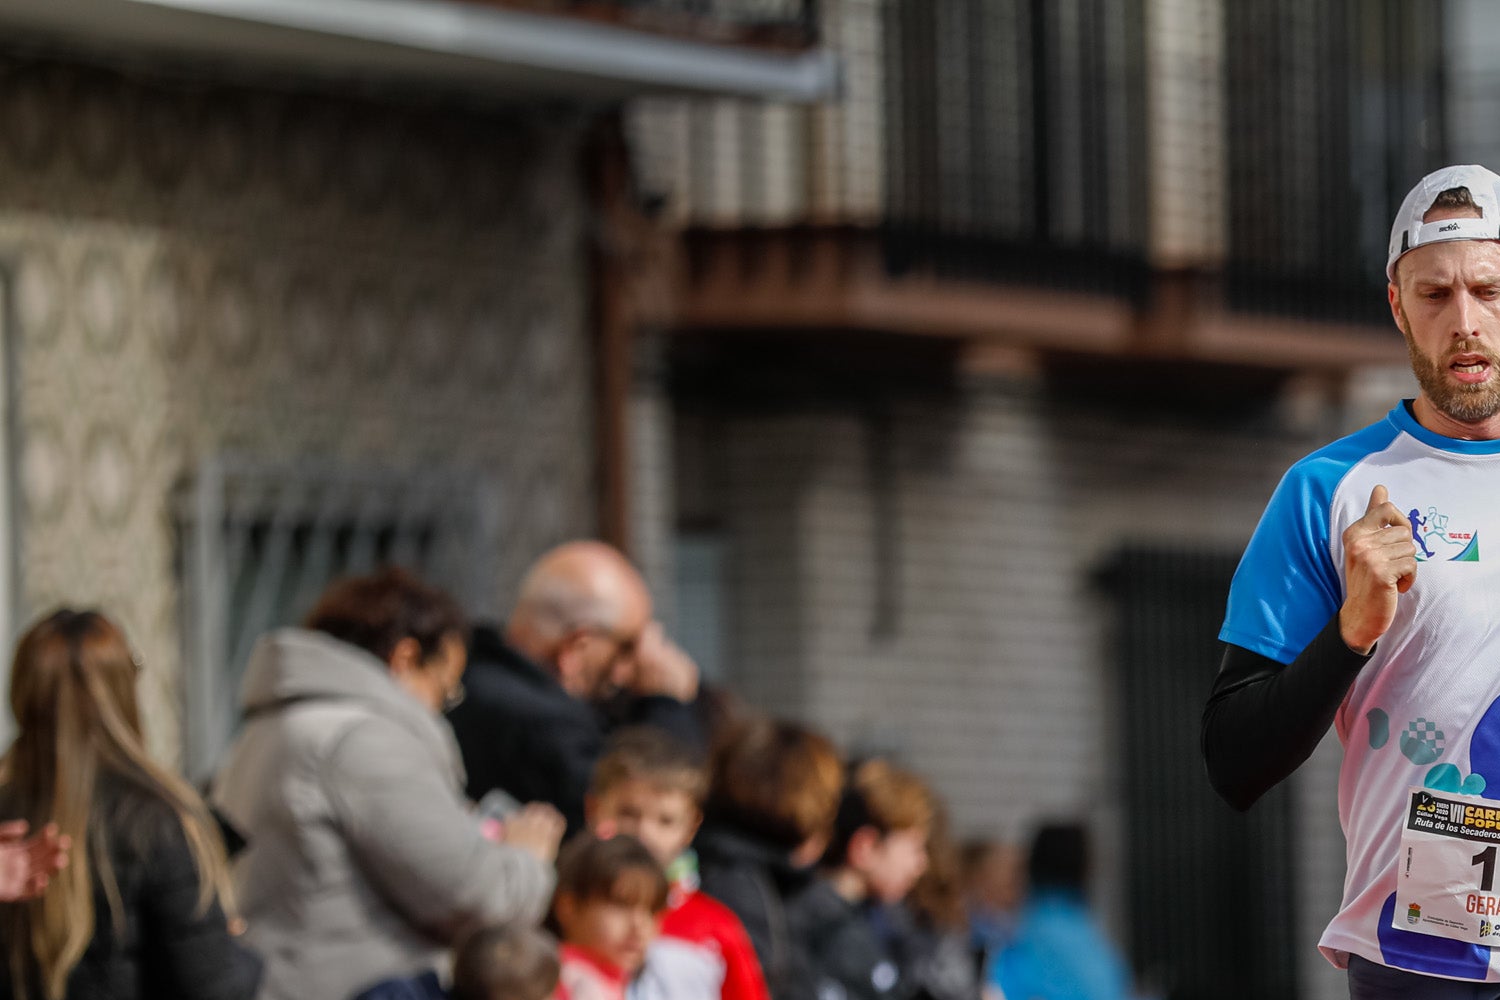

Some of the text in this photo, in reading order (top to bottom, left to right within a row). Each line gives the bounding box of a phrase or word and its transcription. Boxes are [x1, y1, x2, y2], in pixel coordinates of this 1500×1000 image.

[1450, 803, 1465, 824] VII
[1414, 817, 1433, 828] Ruta
[1434, 821, 1445, 830] de
[1446, 823, 1458, 833] los
